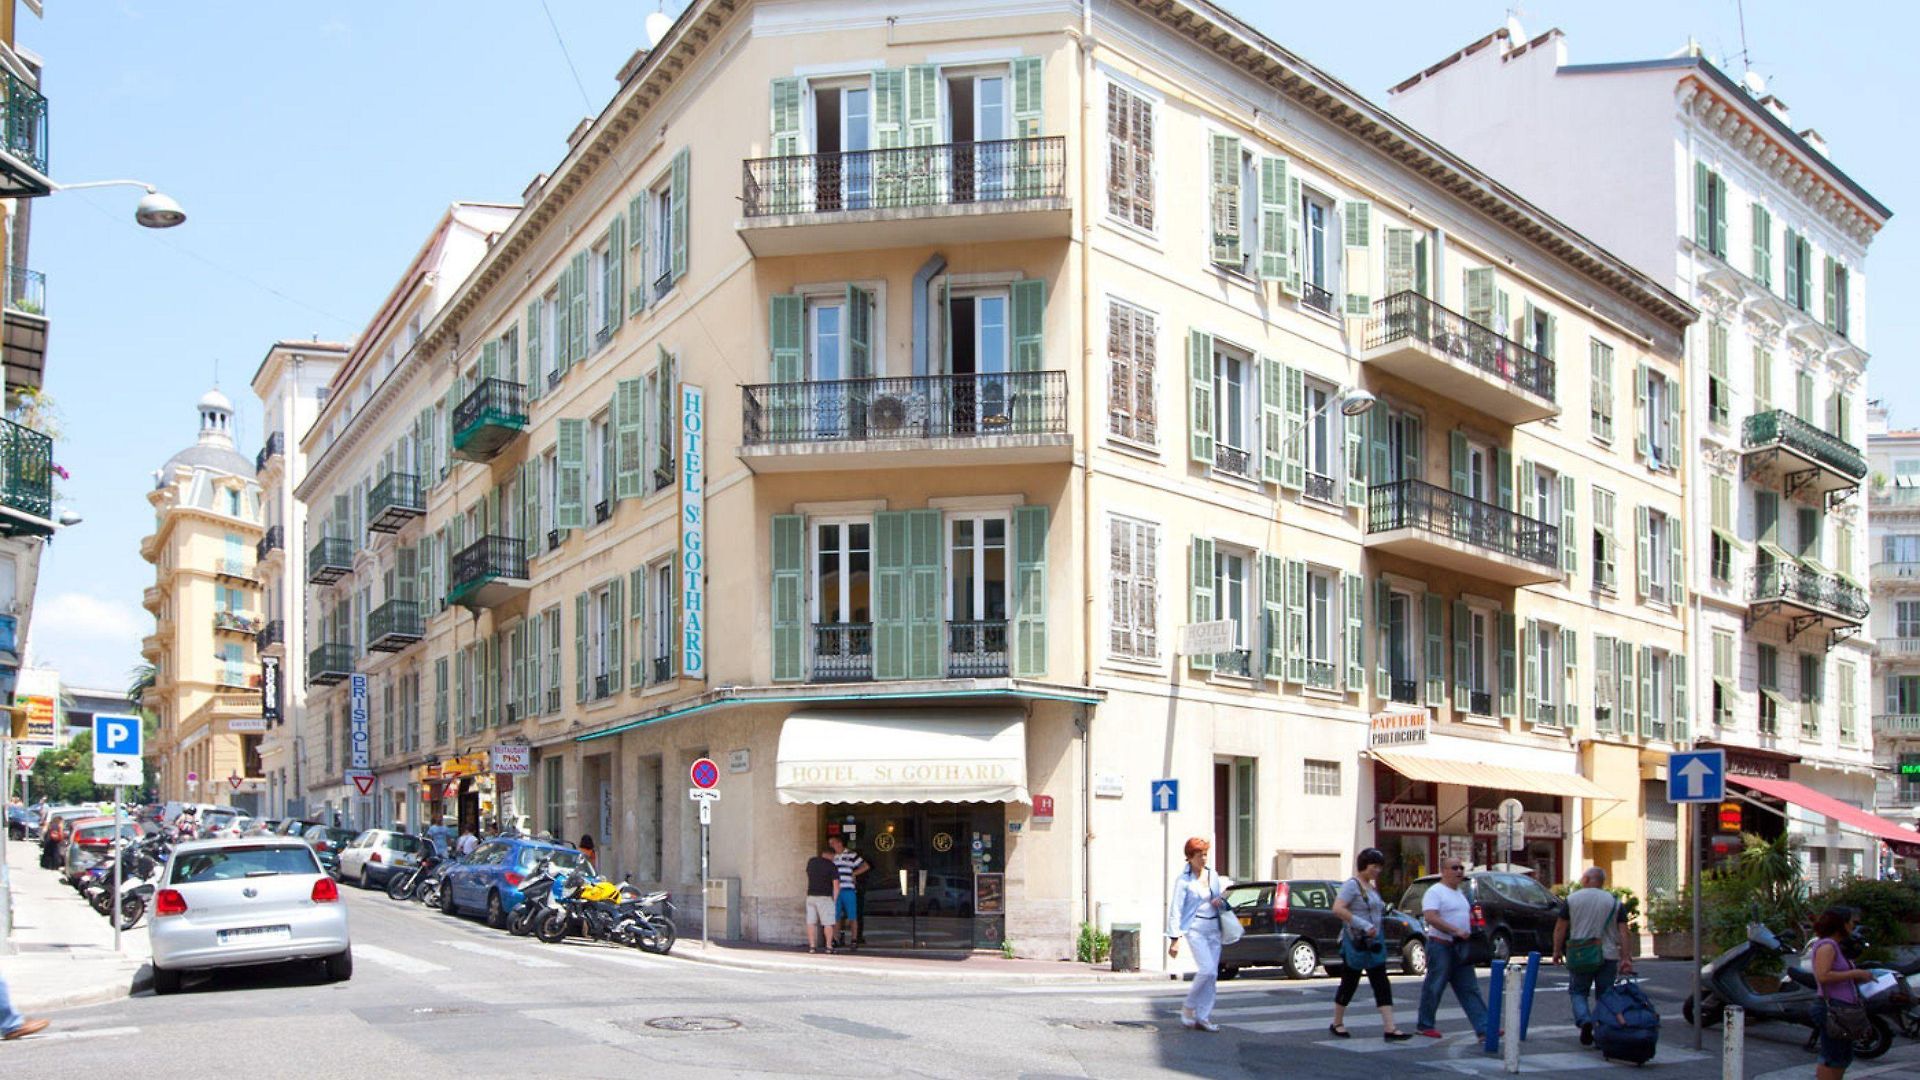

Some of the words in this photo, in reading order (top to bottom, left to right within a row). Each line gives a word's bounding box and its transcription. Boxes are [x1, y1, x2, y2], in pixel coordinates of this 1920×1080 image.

[684, 392, 701, 493] HOTEL
[684, 531, 702, 671] GOTHARD
[1188, 622, 1228, 638] HOTEL
[353, 676, 367, 753] BRISTOL
[1372, 713, 1425, 729] PAPETERIE
[107, 723, 129, 749] P
[1372, 729, 1425, 744] PHOTOCOPIE
[792, 765, 858, 782] HOTEL
[902, 764, 1005, 780] GOTHARD
[1384, 808, 1433, 829] PHOTOCOPIE
